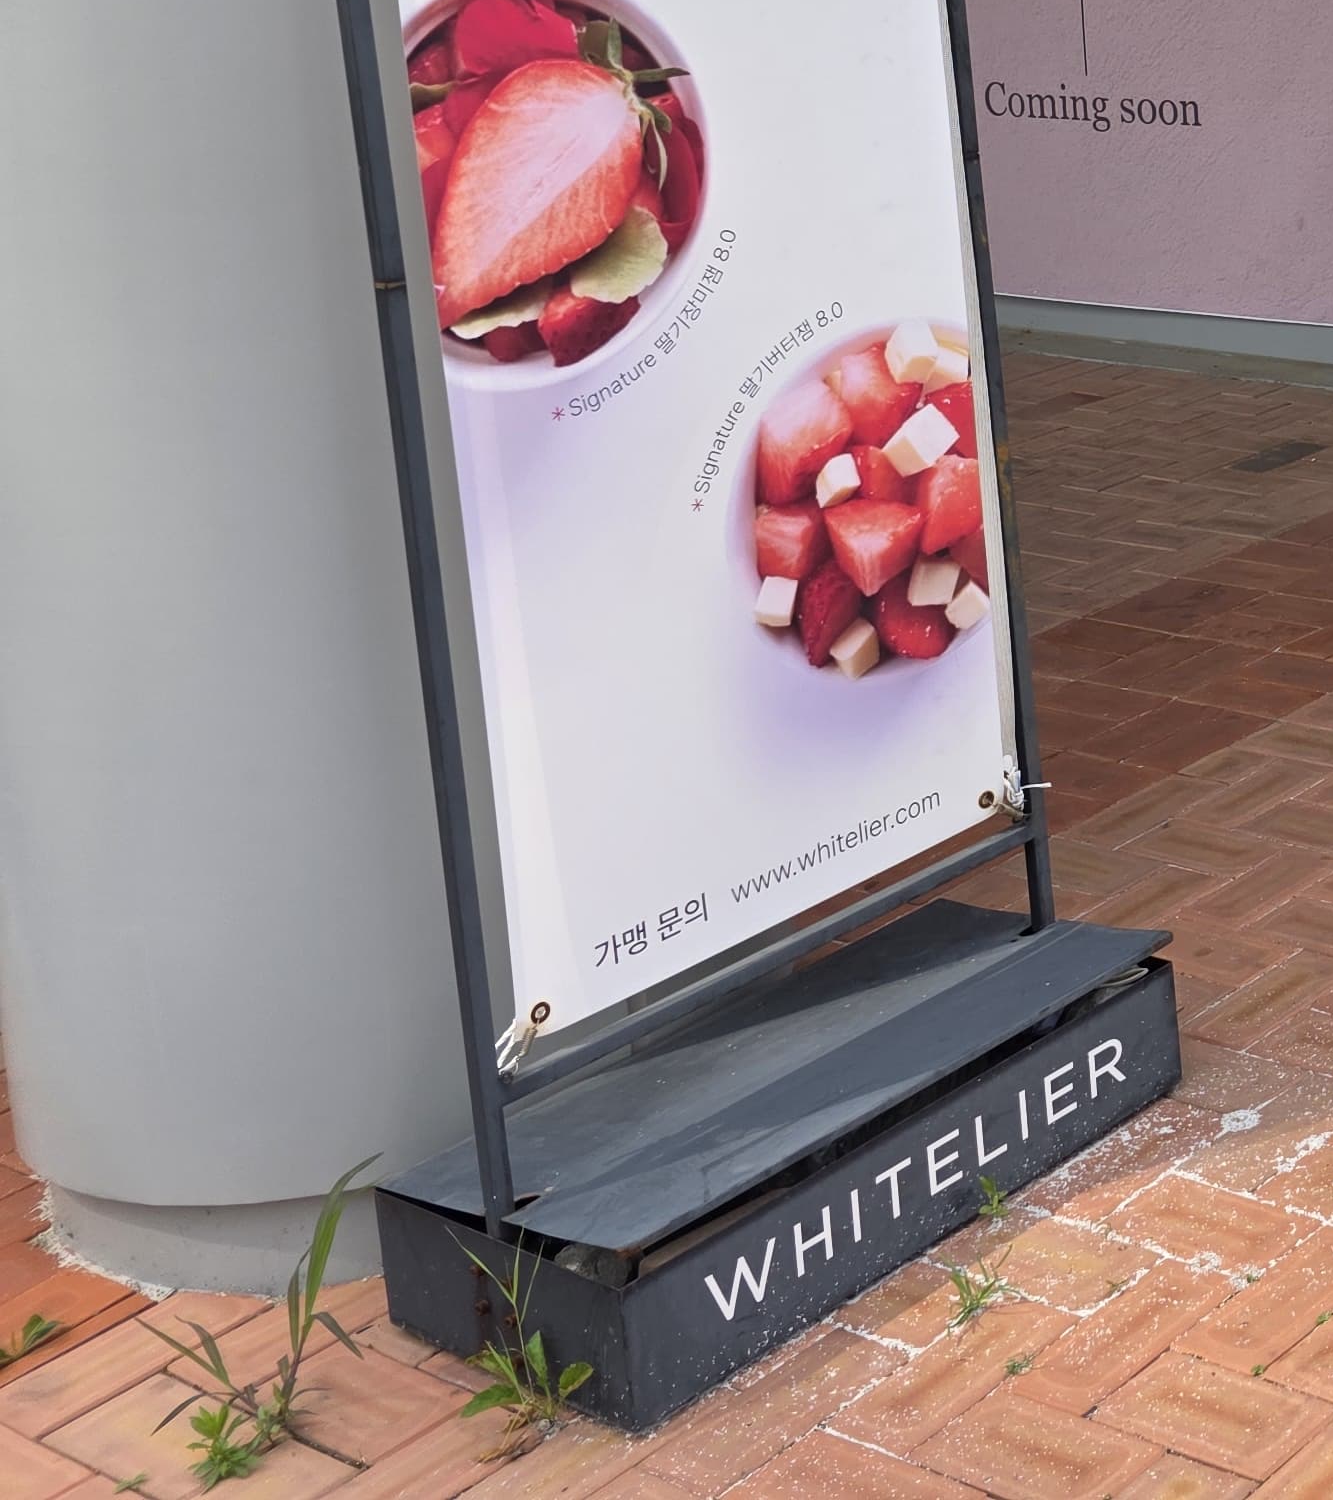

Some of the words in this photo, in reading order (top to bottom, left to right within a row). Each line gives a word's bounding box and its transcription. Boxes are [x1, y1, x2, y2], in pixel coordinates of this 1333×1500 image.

[984, 81, 1110, 132] Coming
[1120, 94, 1202, 127] soon
[568, 351, 657, 420] Signature
[653, 264, 725, 355] 딸기장미잼
[712, 228, 738, 263] 8.0
[693, 400, 746, 495] Signature
[739, 320, 815, 399] 딸기버터잼
[815, 301, 845, 329] 8.0
[594, 919, 648, 970] 가맹
[656, 893, 709, 942] 문의
[730, 788, 941, 904] www.whitelier.com
[704, 1037, 1127, 1322] WHITELIER
